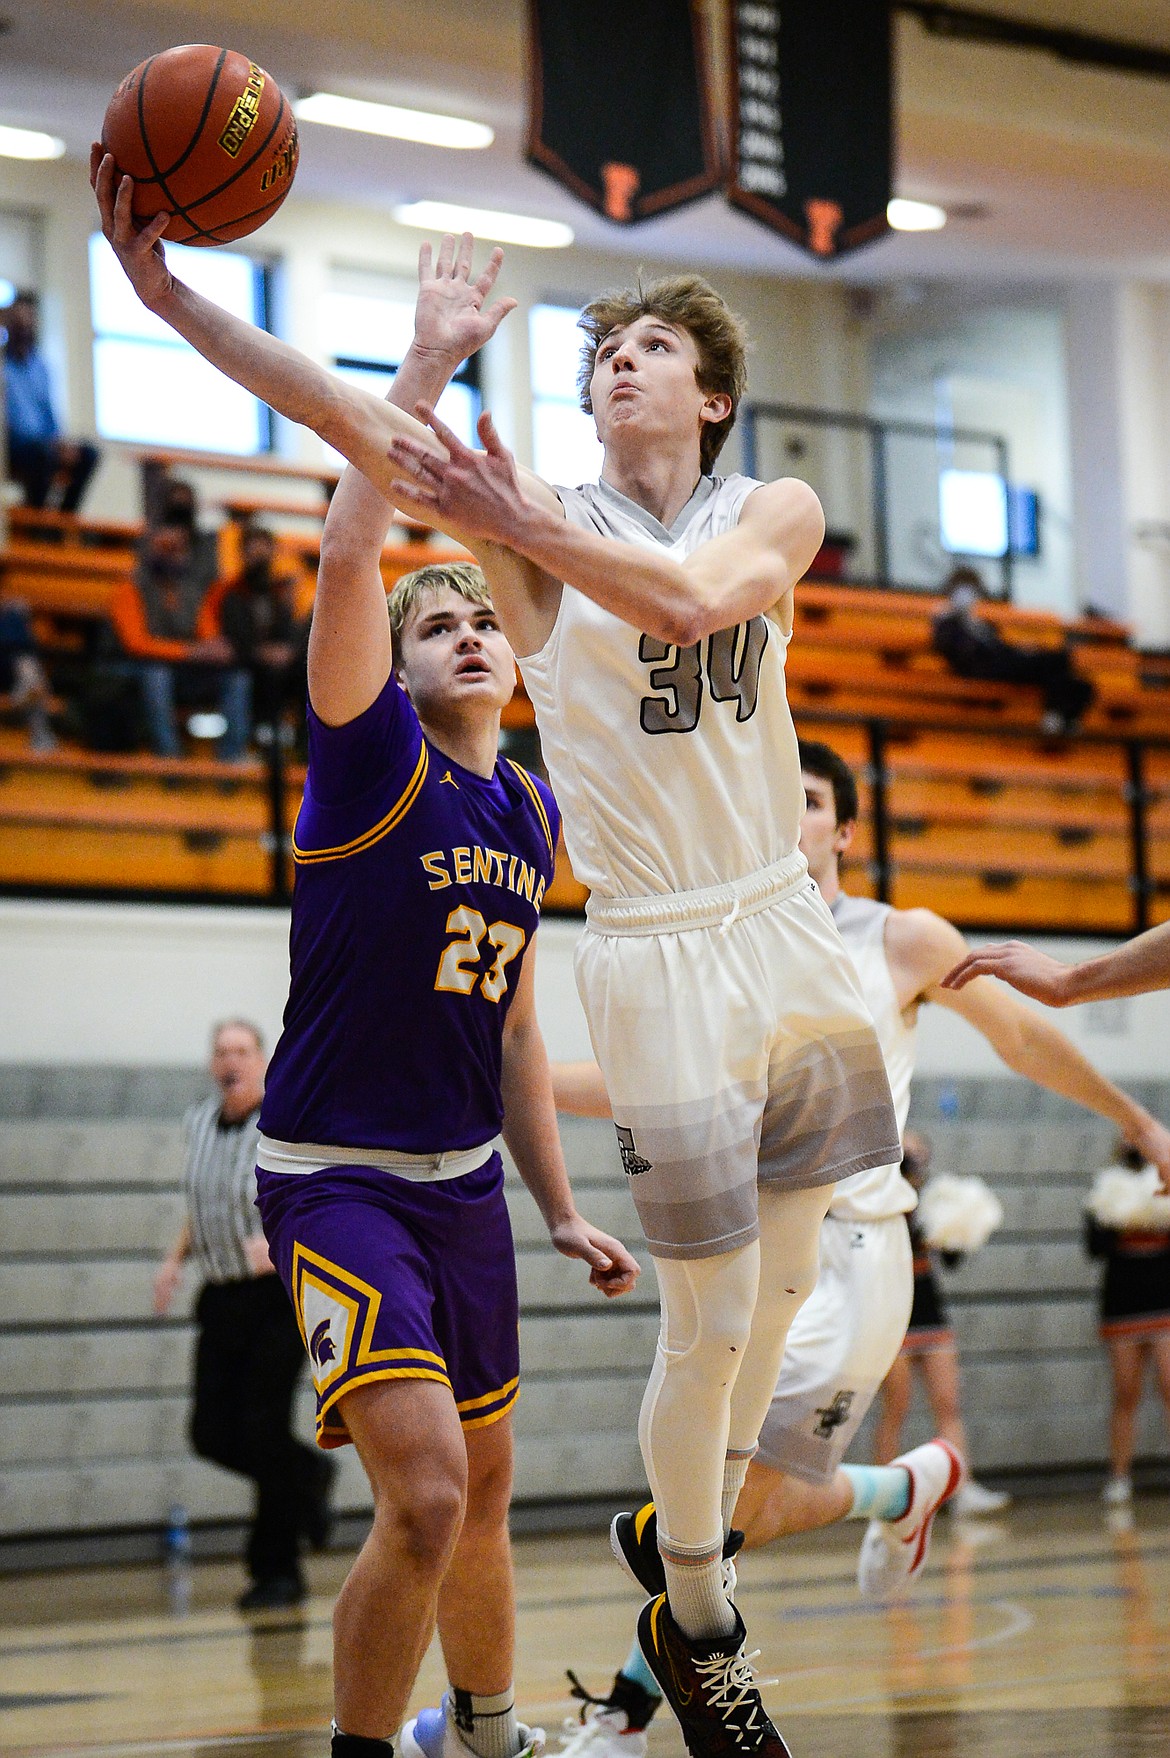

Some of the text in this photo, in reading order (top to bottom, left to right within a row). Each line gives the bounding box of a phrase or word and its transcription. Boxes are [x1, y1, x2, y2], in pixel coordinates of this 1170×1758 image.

[220, 104, 254, 154] PRO
[639, 616, 768, 734] 34
[434, 904, 526, 1004] 23
